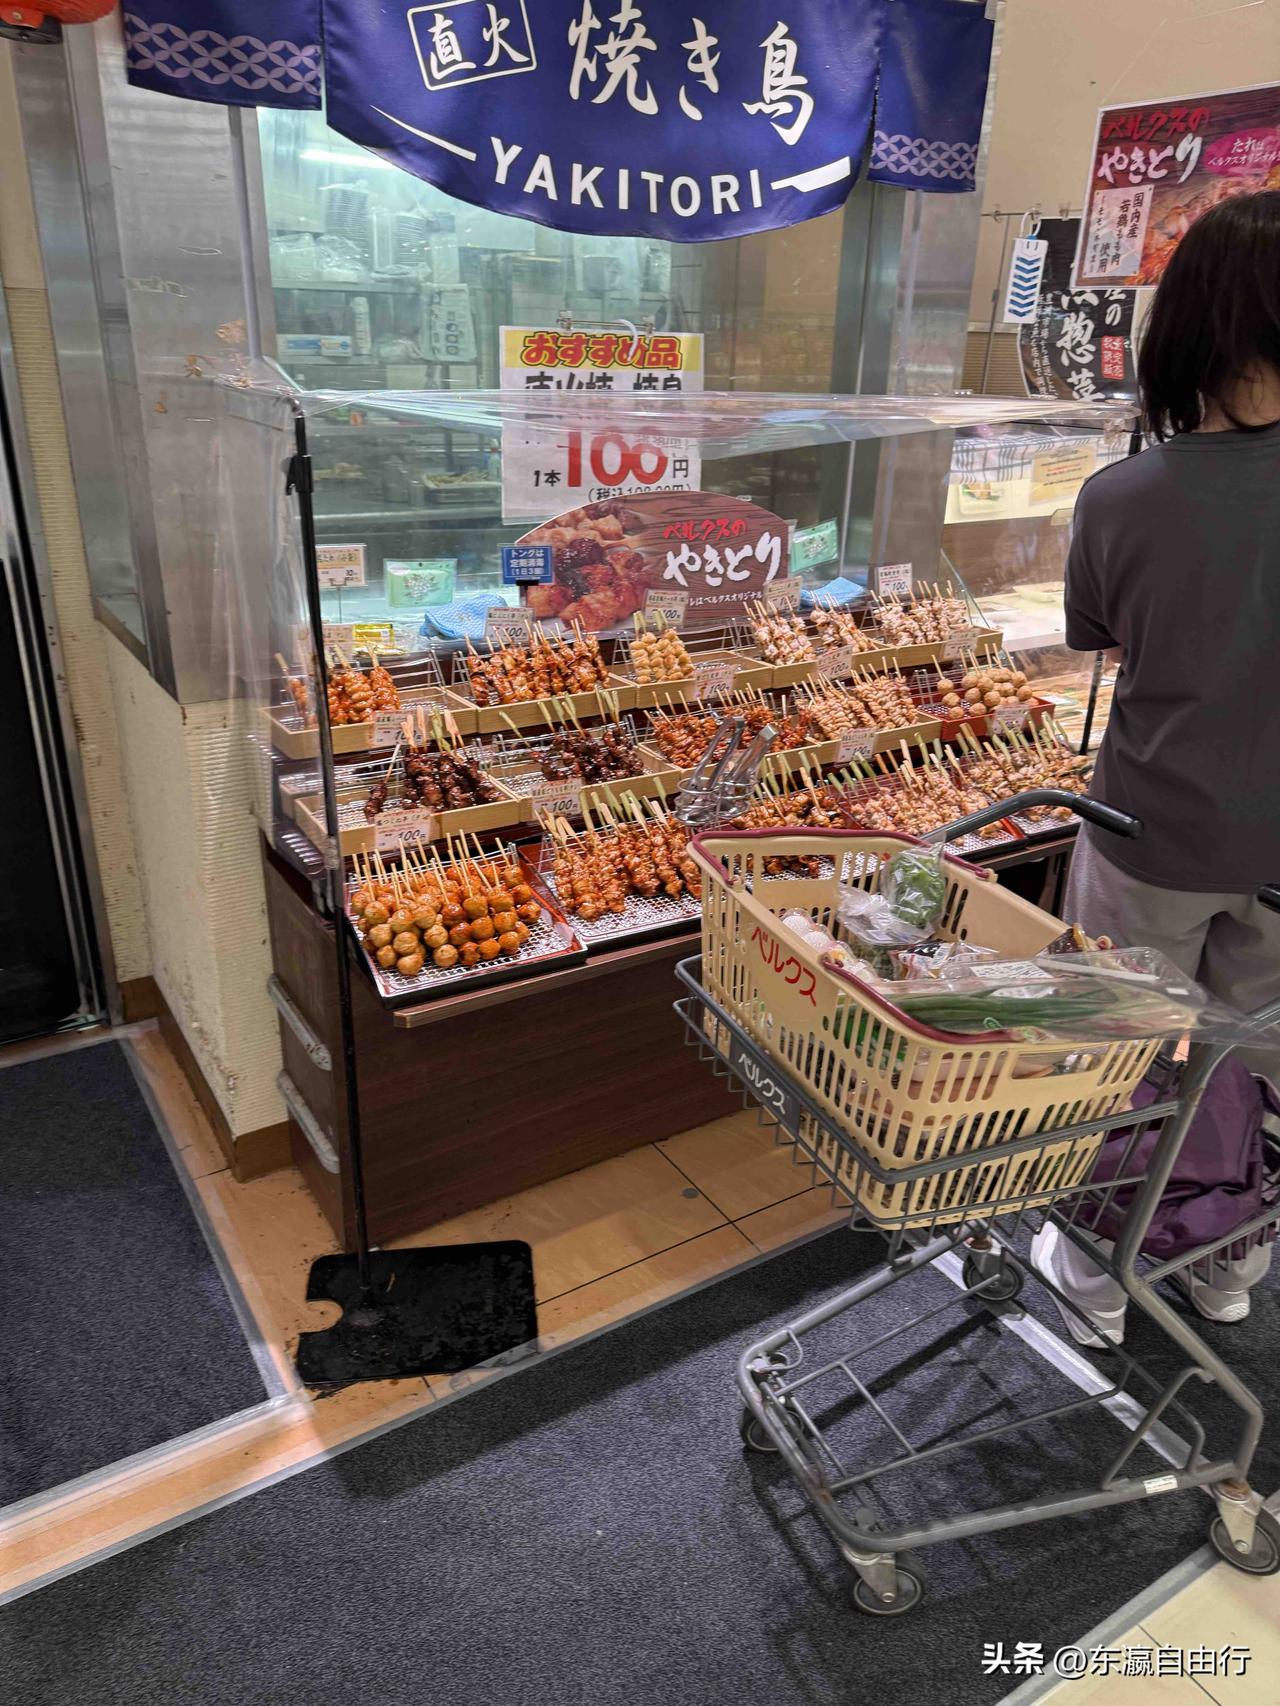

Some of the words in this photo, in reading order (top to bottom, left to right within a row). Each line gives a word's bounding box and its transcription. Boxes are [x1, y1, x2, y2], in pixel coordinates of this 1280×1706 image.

[429, 4, 530, 79] 直火
[568, 0, 815, 146] 焼き鳥
[1101, 106, 1211, 141] ベルクスの
[490, 136, 762, 219] YAKITORI
[1097, 133, 1203, 184] やきとり
[1126, 192, 1144, 238] 国内産
[521, 331, 683, 370] おすすめ品
[533, 469, 561, 487] 1本
[511, 549, 545, 558] トングは
[662, 517, 747, 541] ベルクスの
[663, 532, 782, 587] やきとり
[751, 926, 817, 1007] ベルクス
[738, 1053, 786, 1115] ベルクス
